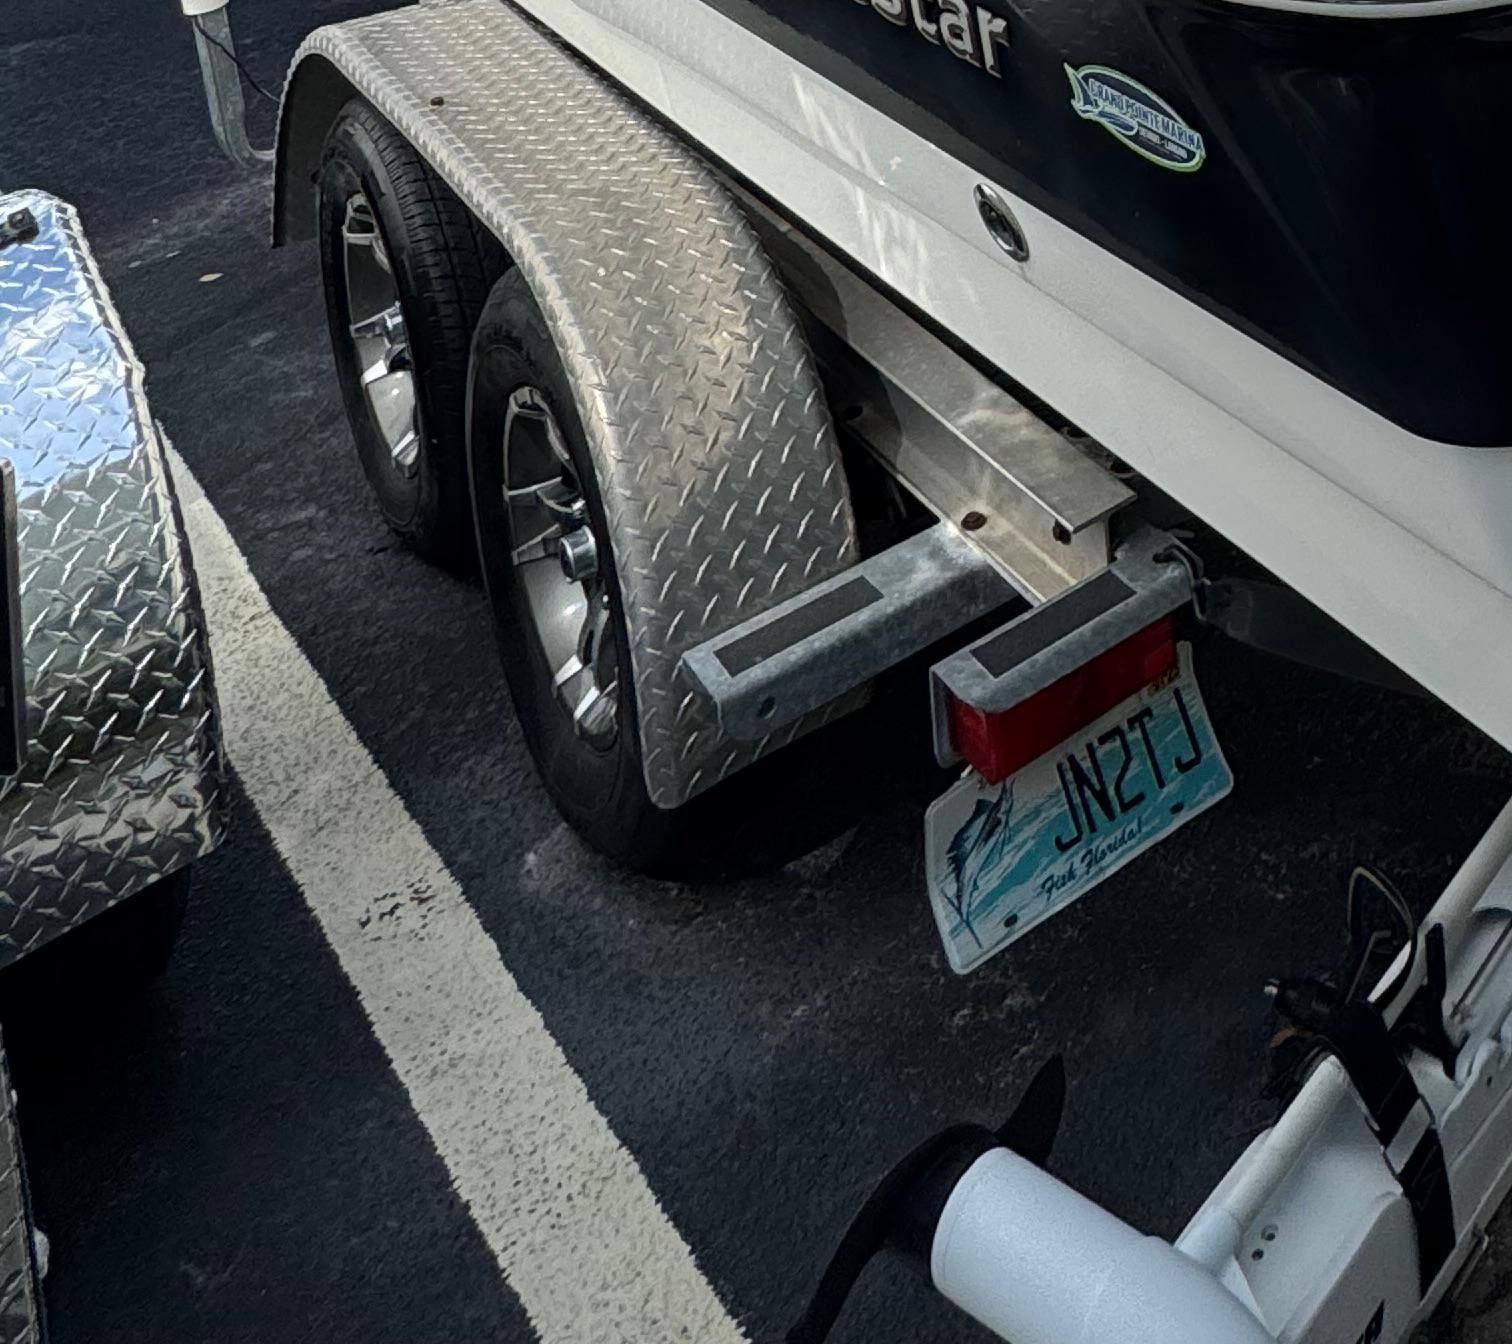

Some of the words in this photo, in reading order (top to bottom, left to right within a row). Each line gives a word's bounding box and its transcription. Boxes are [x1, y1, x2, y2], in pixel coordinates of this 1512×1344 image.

[1160, 115, 1202, 151] MARINA
[1054, 687, 1203, 853] JN2TJ
[1040, 864, 1077, 902] Fish
